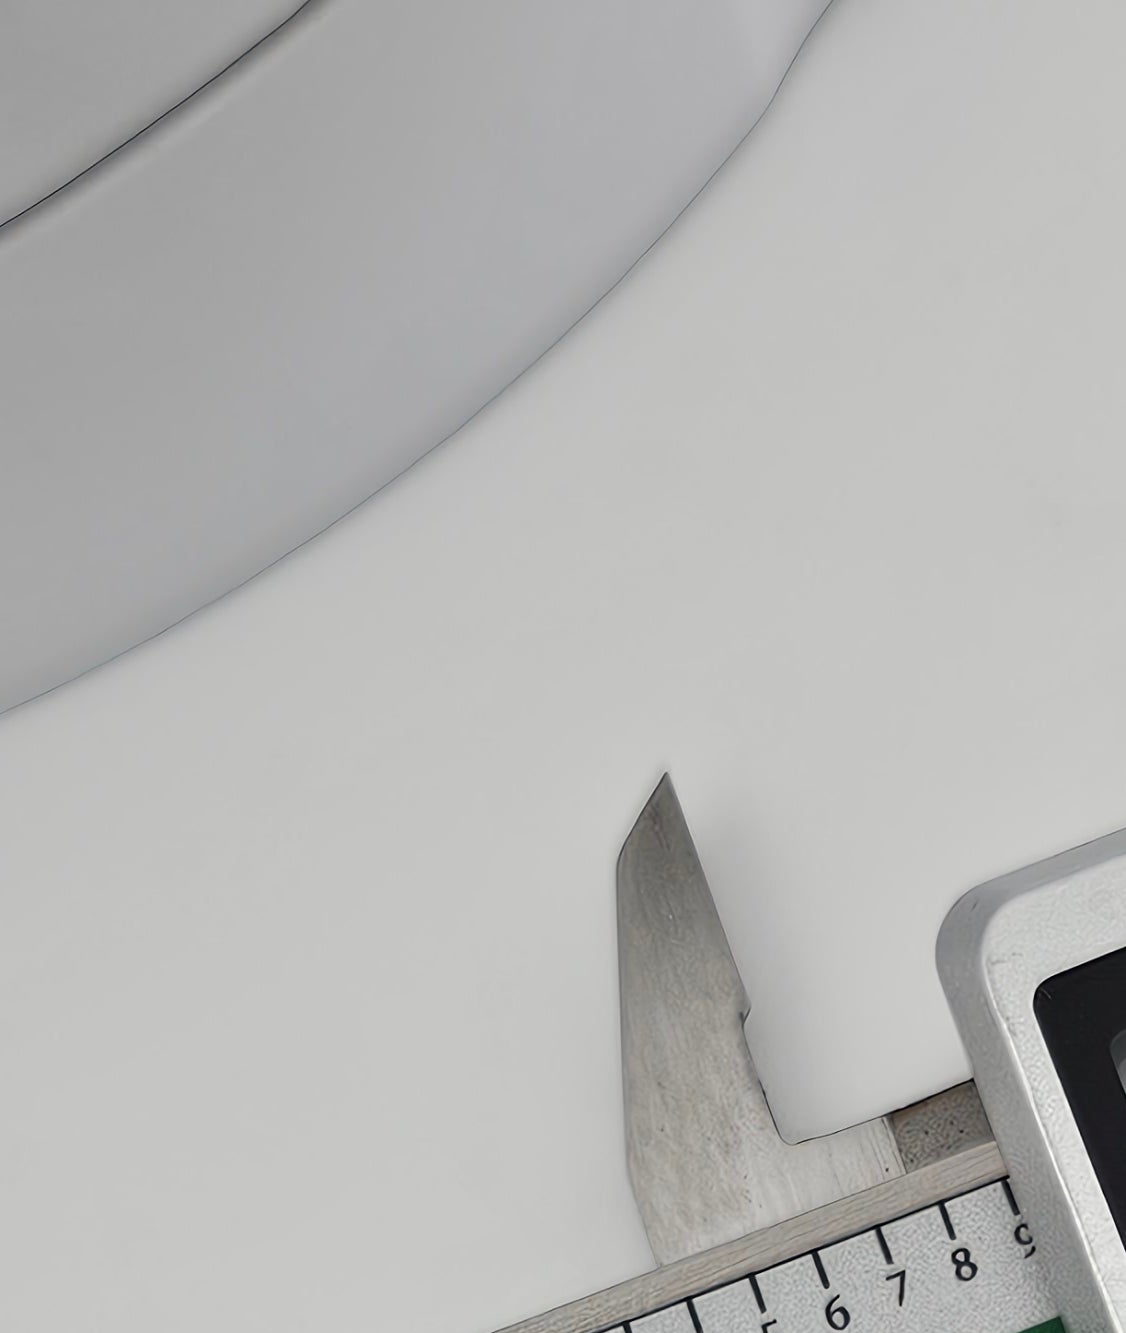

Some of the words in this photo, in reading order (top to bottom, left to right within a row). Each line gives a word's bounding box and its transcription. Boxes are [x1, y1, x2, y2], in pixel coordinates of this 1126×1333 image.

[824, 1293, 851, 1331] 6
[885, 1269, 907, 1307] 7
[950, 1246, 979, 1282] 8
